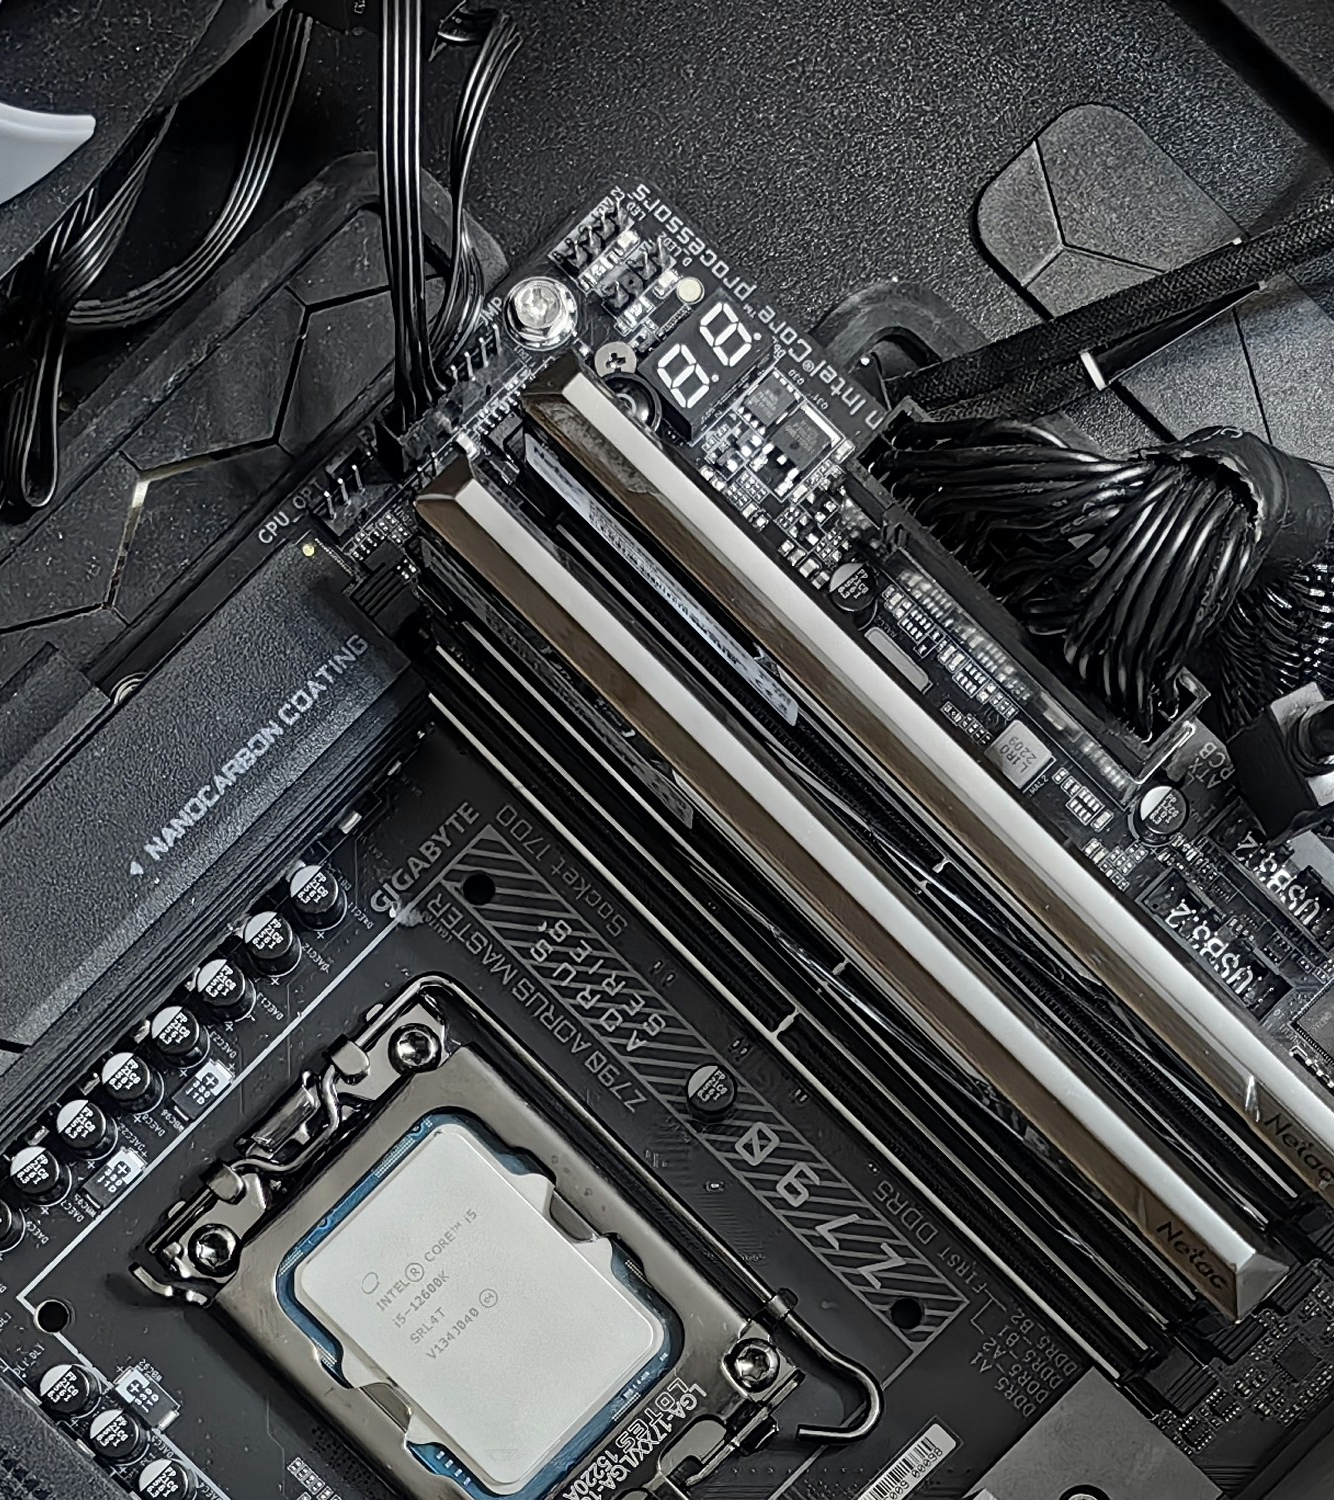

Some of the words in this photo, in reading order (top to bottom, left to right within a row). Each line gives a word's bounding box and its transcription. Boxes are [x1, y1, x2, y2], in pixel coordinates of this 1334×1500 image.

[626, 182, 756, 303] processors
[144, 721, 283, 860] NANOCARBON
[278, 634, 369, 726] COATING
[1008, 733, 1039, 768] 2209
[366, 800, 481, 916] GIGABYTE
[494, 803, 552, 860] 1700
[315, 872, 327, 884] FP
[547, 856, 629, 936] Socket
[270, 918, 282, 931] FP
[426, 892, 518, 985] MASTER
[221, 965, 233, 977] FP
[527, 936, 648, 1056] AORUS
[546, 918, 667, 1036] SERIES
[176, 1012, 188, 1025] FP
[510, 976, 591, 1056] AORUS
[126, 1059, 139, 1071] FP
[583, 1049, 647, 1113] Z790
[713, 1069, 725, 1081] FP
[36, 1154, 48, 1166] FP
[461, 1208, 477, 1224] i5
[734, 1122, 908, 1290] Z790
[872, 1178, 938, 1244] DDR5
[937, 1245, 987, 1293] FIRST
[1155, 1215, 1234, 1295] Netac
[391, 1269, 450, 1328] i5-12600K
[408, 1306, 446, 1344] SRL4T
[65, 1371, 77, 1383] FP
[967, 1347, 1039, 1419] DDR5_A1
[980, 1333, 1052, 1405] DDR5_A2
[996, 1321, 1066, 1391] DDR5_B1
[115, 1416, 127, 1428] FP
[613, 1376, 689, 1453] LOTES
[164, 1467, 177, 1479] FP
[910, 1446, 944, 1480] 00098
